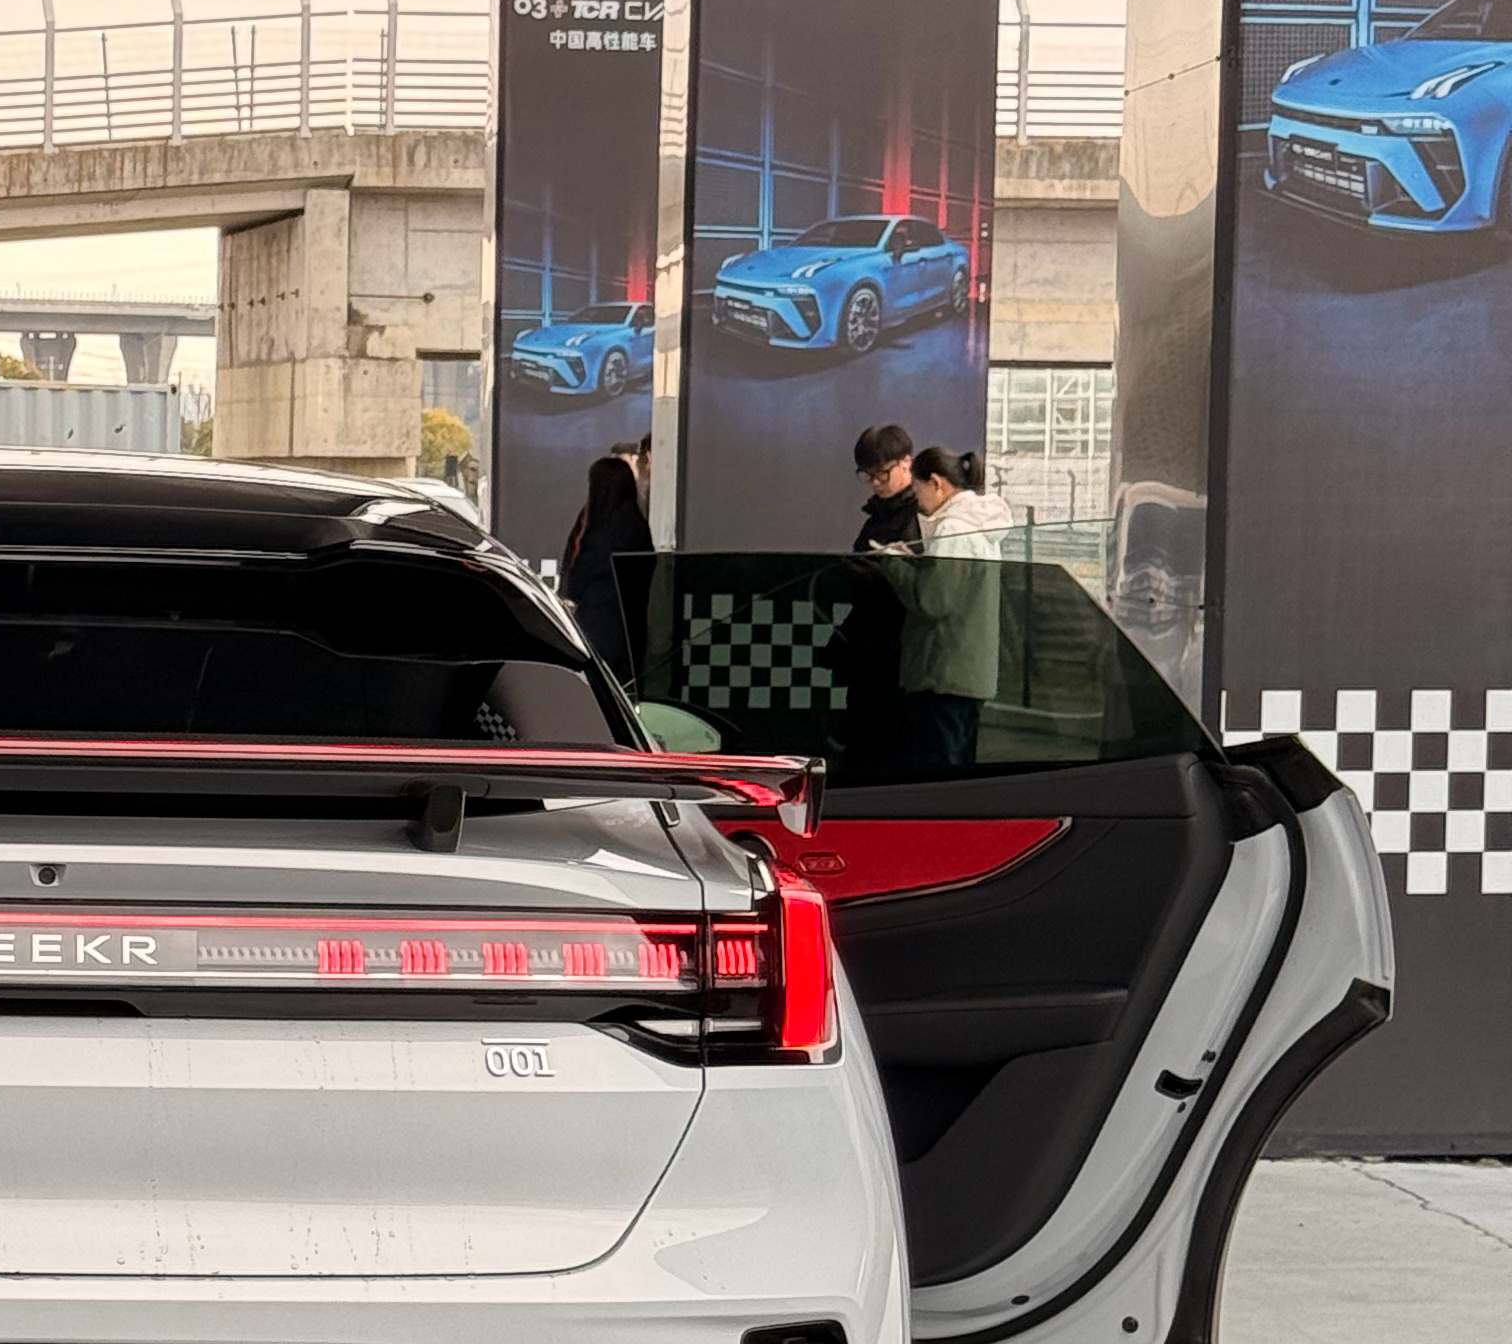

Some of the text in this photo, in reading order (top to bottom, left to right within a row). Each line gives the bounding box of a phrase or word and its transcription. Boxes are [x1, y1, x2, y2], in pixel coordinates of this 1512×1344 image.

[571, 0, 620, 20] TCR
[549, 30, 657, 51] 中国高性能车
[485, 1046, 556, 1077] 001
